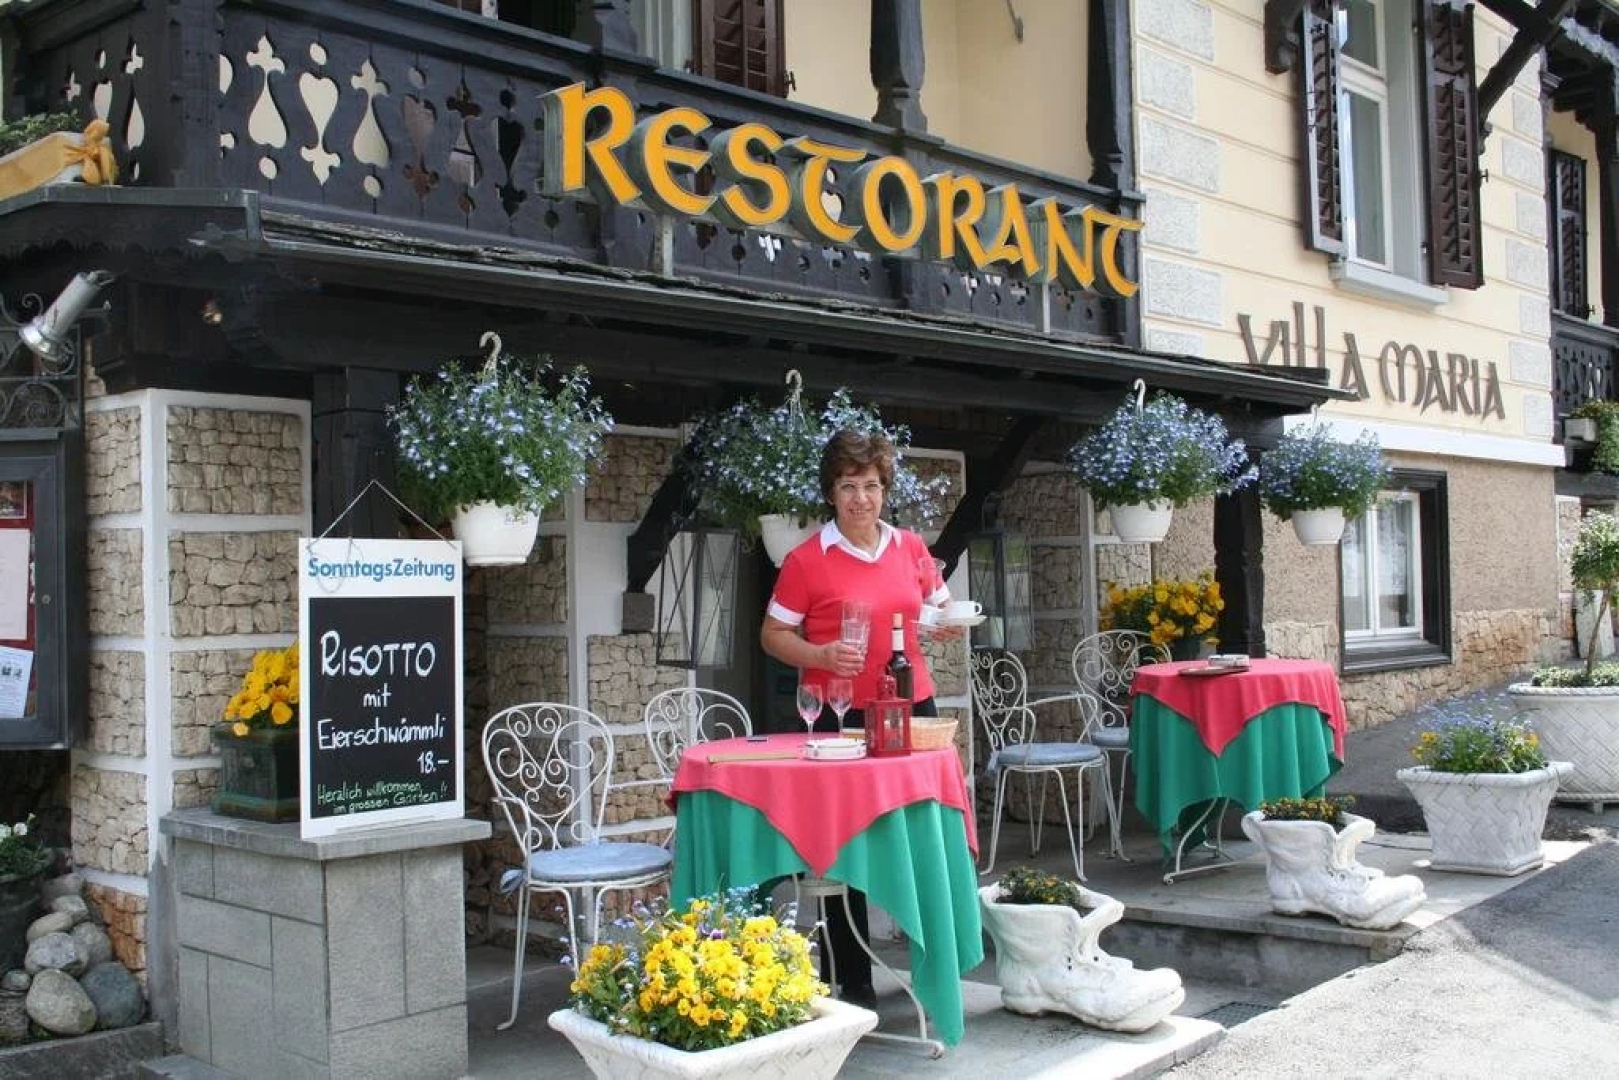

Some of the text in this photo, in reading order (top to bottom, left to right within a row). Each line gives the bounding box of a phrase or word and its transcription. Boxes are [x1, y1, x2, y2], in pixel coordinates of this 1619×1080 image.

[543, 80, 1146, 299] RESTORANT
[1379, 340, 1506, 423] MARIA
[308, 557, 456, 582] SonntagsZeitung
[320, 630, 436, 677] RISOTTO
[363, 682, 392, 707] mit
[317, 780, 421, 805] Herzlich willkommen
